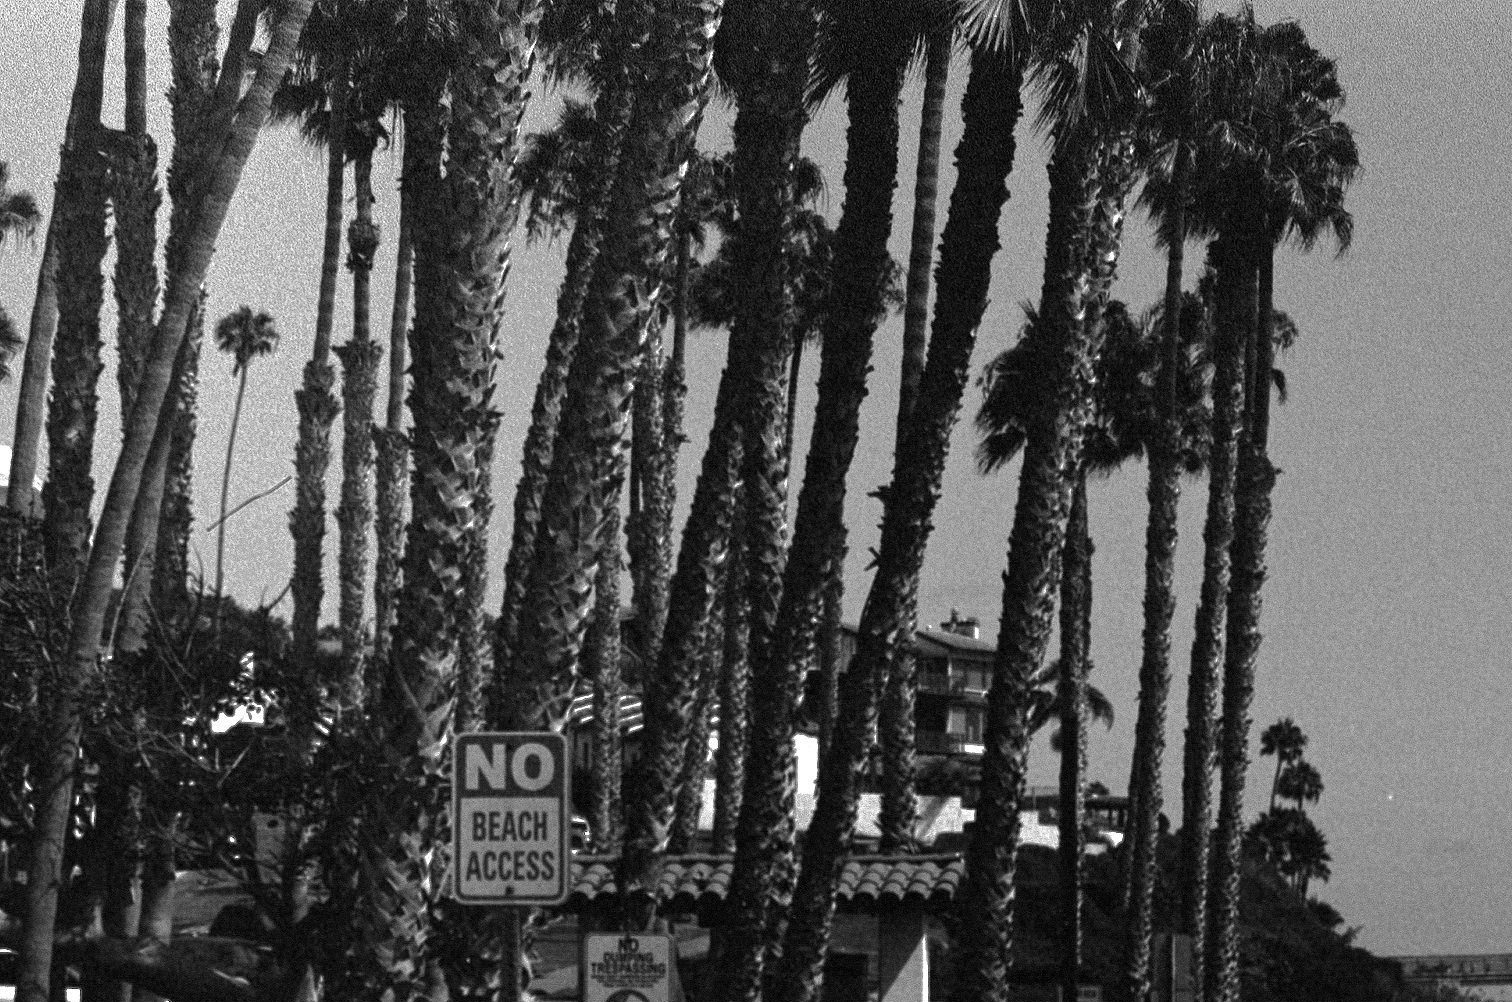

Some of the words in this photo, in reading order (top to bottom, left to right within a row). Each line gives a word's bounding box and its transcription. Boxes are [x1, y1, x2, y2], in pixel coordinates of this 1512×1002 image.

[465, 743, 555, 791] NO
[472, 811, 548, 841] BEACH
[466, 850, 555, 882] ACCESS
[618, 938, 639, 953] NO
